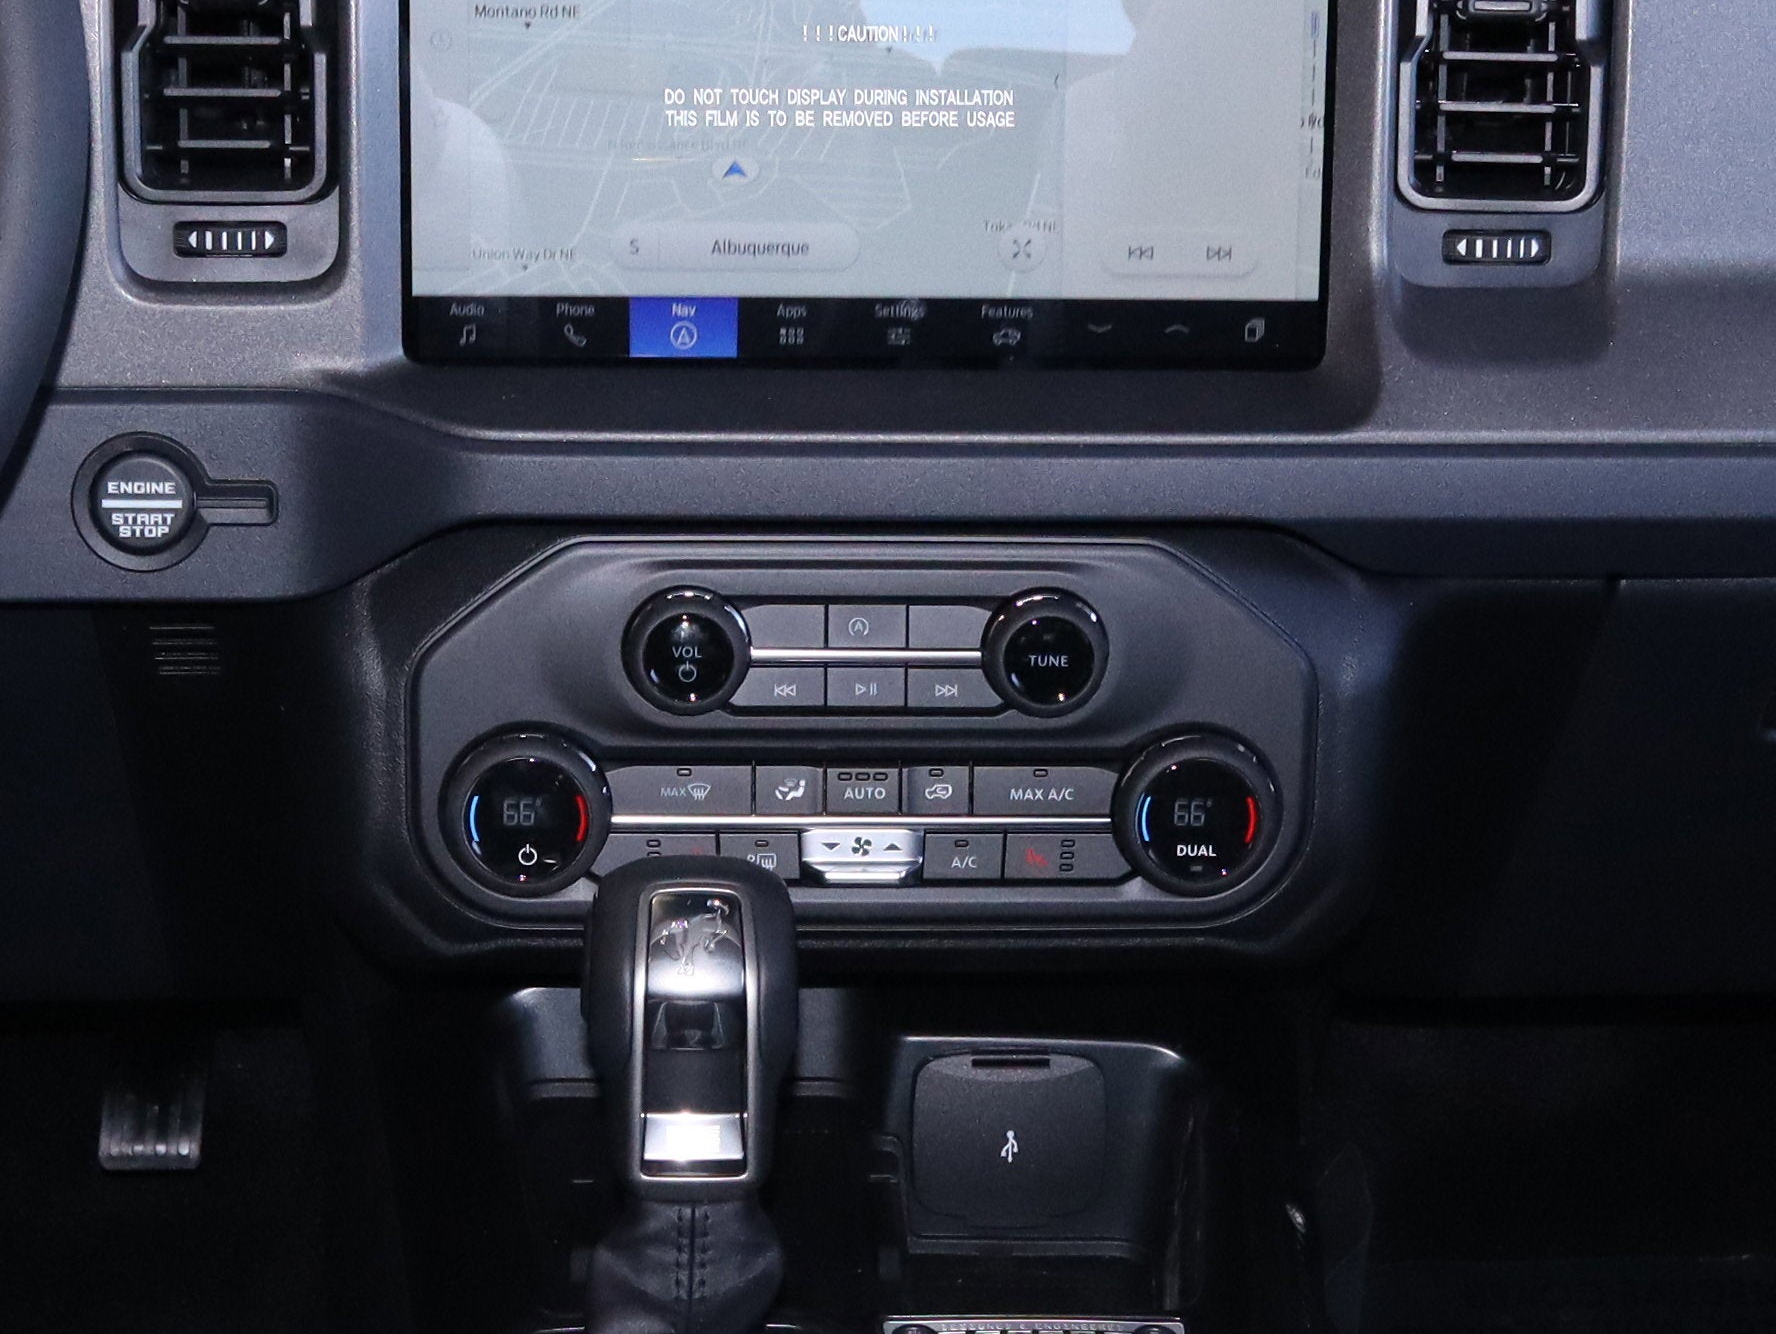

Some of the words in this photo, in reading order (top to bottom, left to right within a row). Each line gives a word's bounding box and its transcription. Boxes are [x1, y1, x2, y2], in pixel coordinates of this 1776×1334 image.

[540, 4, 559, 19] Rd
[837, 25, 899, 43] CAUTION
[664, 88, 685, 106] DO
[693, 88, 722, 106] NOT
[731, 88, 779, 106] TOUCH
[787, 88, 847, 106] DISPLAY
[854, 88, 908, 106] DURING
[915, 88, 1014, 106] INSTALLATION
[666, 110, 697, 127] THIS
[705, 110, 738, 127] FILM
[745, 110, 760, 127] IS
[767, 110, 786, 127] TO
[795, 110, 815, 127] BE
[824, 110, 893, 127] REMOVED
[901, 110, 958, 127] BEFORE
[966, 110, 1015, 127] USAGE
[629, 240, 639, 254] S
[711, 238, 810, 259] Albuquerque
[449, 302, 485, 317] Audio
[556, 302, 596, 317] Phone
[672, 302, 696, 317] Nav
[777, 302, 807, 320] Apps
[874, 303, 924, 320] Settings
[981, 303, 1034, 319] Features
[107, 481, 177, 494] ENGINE
[111, 512, 175, 525] START
[119, 525, 170, 538] STOP
[671, 646, 702, 659] VOL
[1028, 655, 1069, 667] TUNE
[660, 787, 686, 797] MAX
[844, 787, 886, 800] AUTO
[1010, 787, 1044, 800] MAX
[1047, 786, 1074, 801] A/C
[1176, 844, 1217, 857] DUAL
[951, 855, 978, 870] A/C
